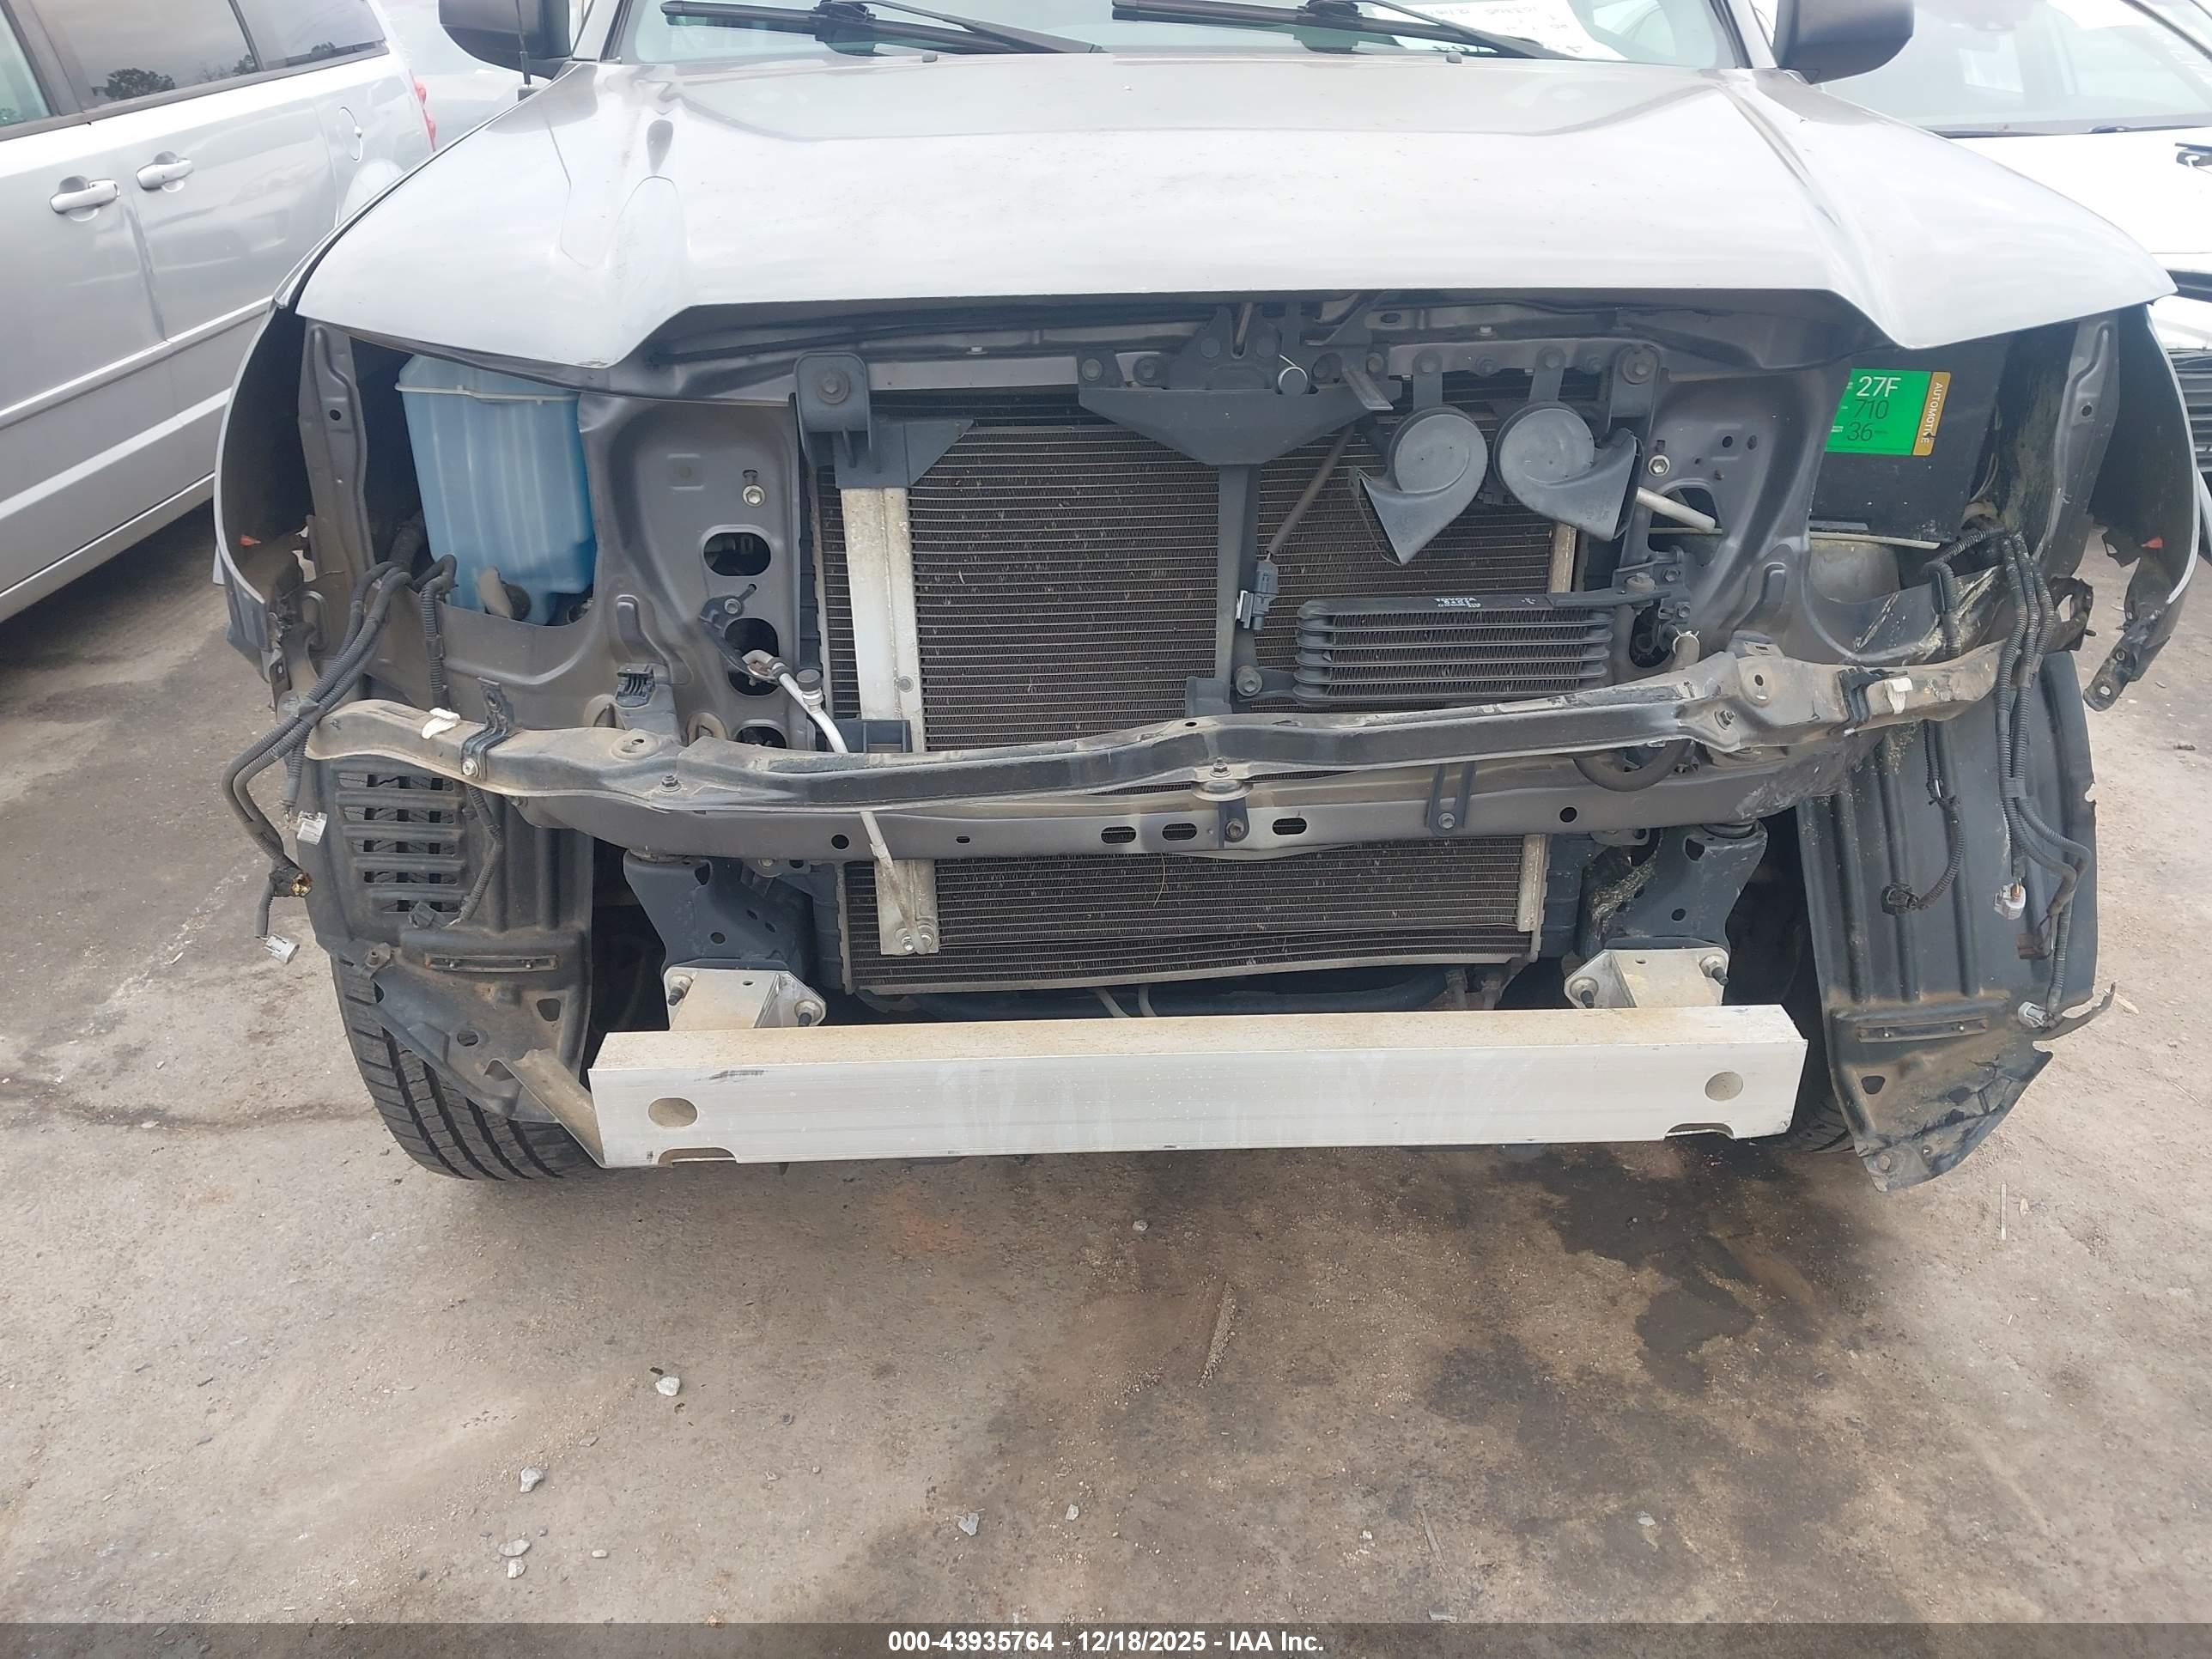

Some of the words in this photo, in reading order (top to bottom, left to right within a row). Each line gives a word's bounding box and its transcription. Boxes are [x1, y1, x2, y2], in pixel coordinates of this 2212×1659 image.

[1856, 375, 1902, 398] 27F
[1854, 398, 1889, 420] 710
[1846, 421, 1874, 442] 36
